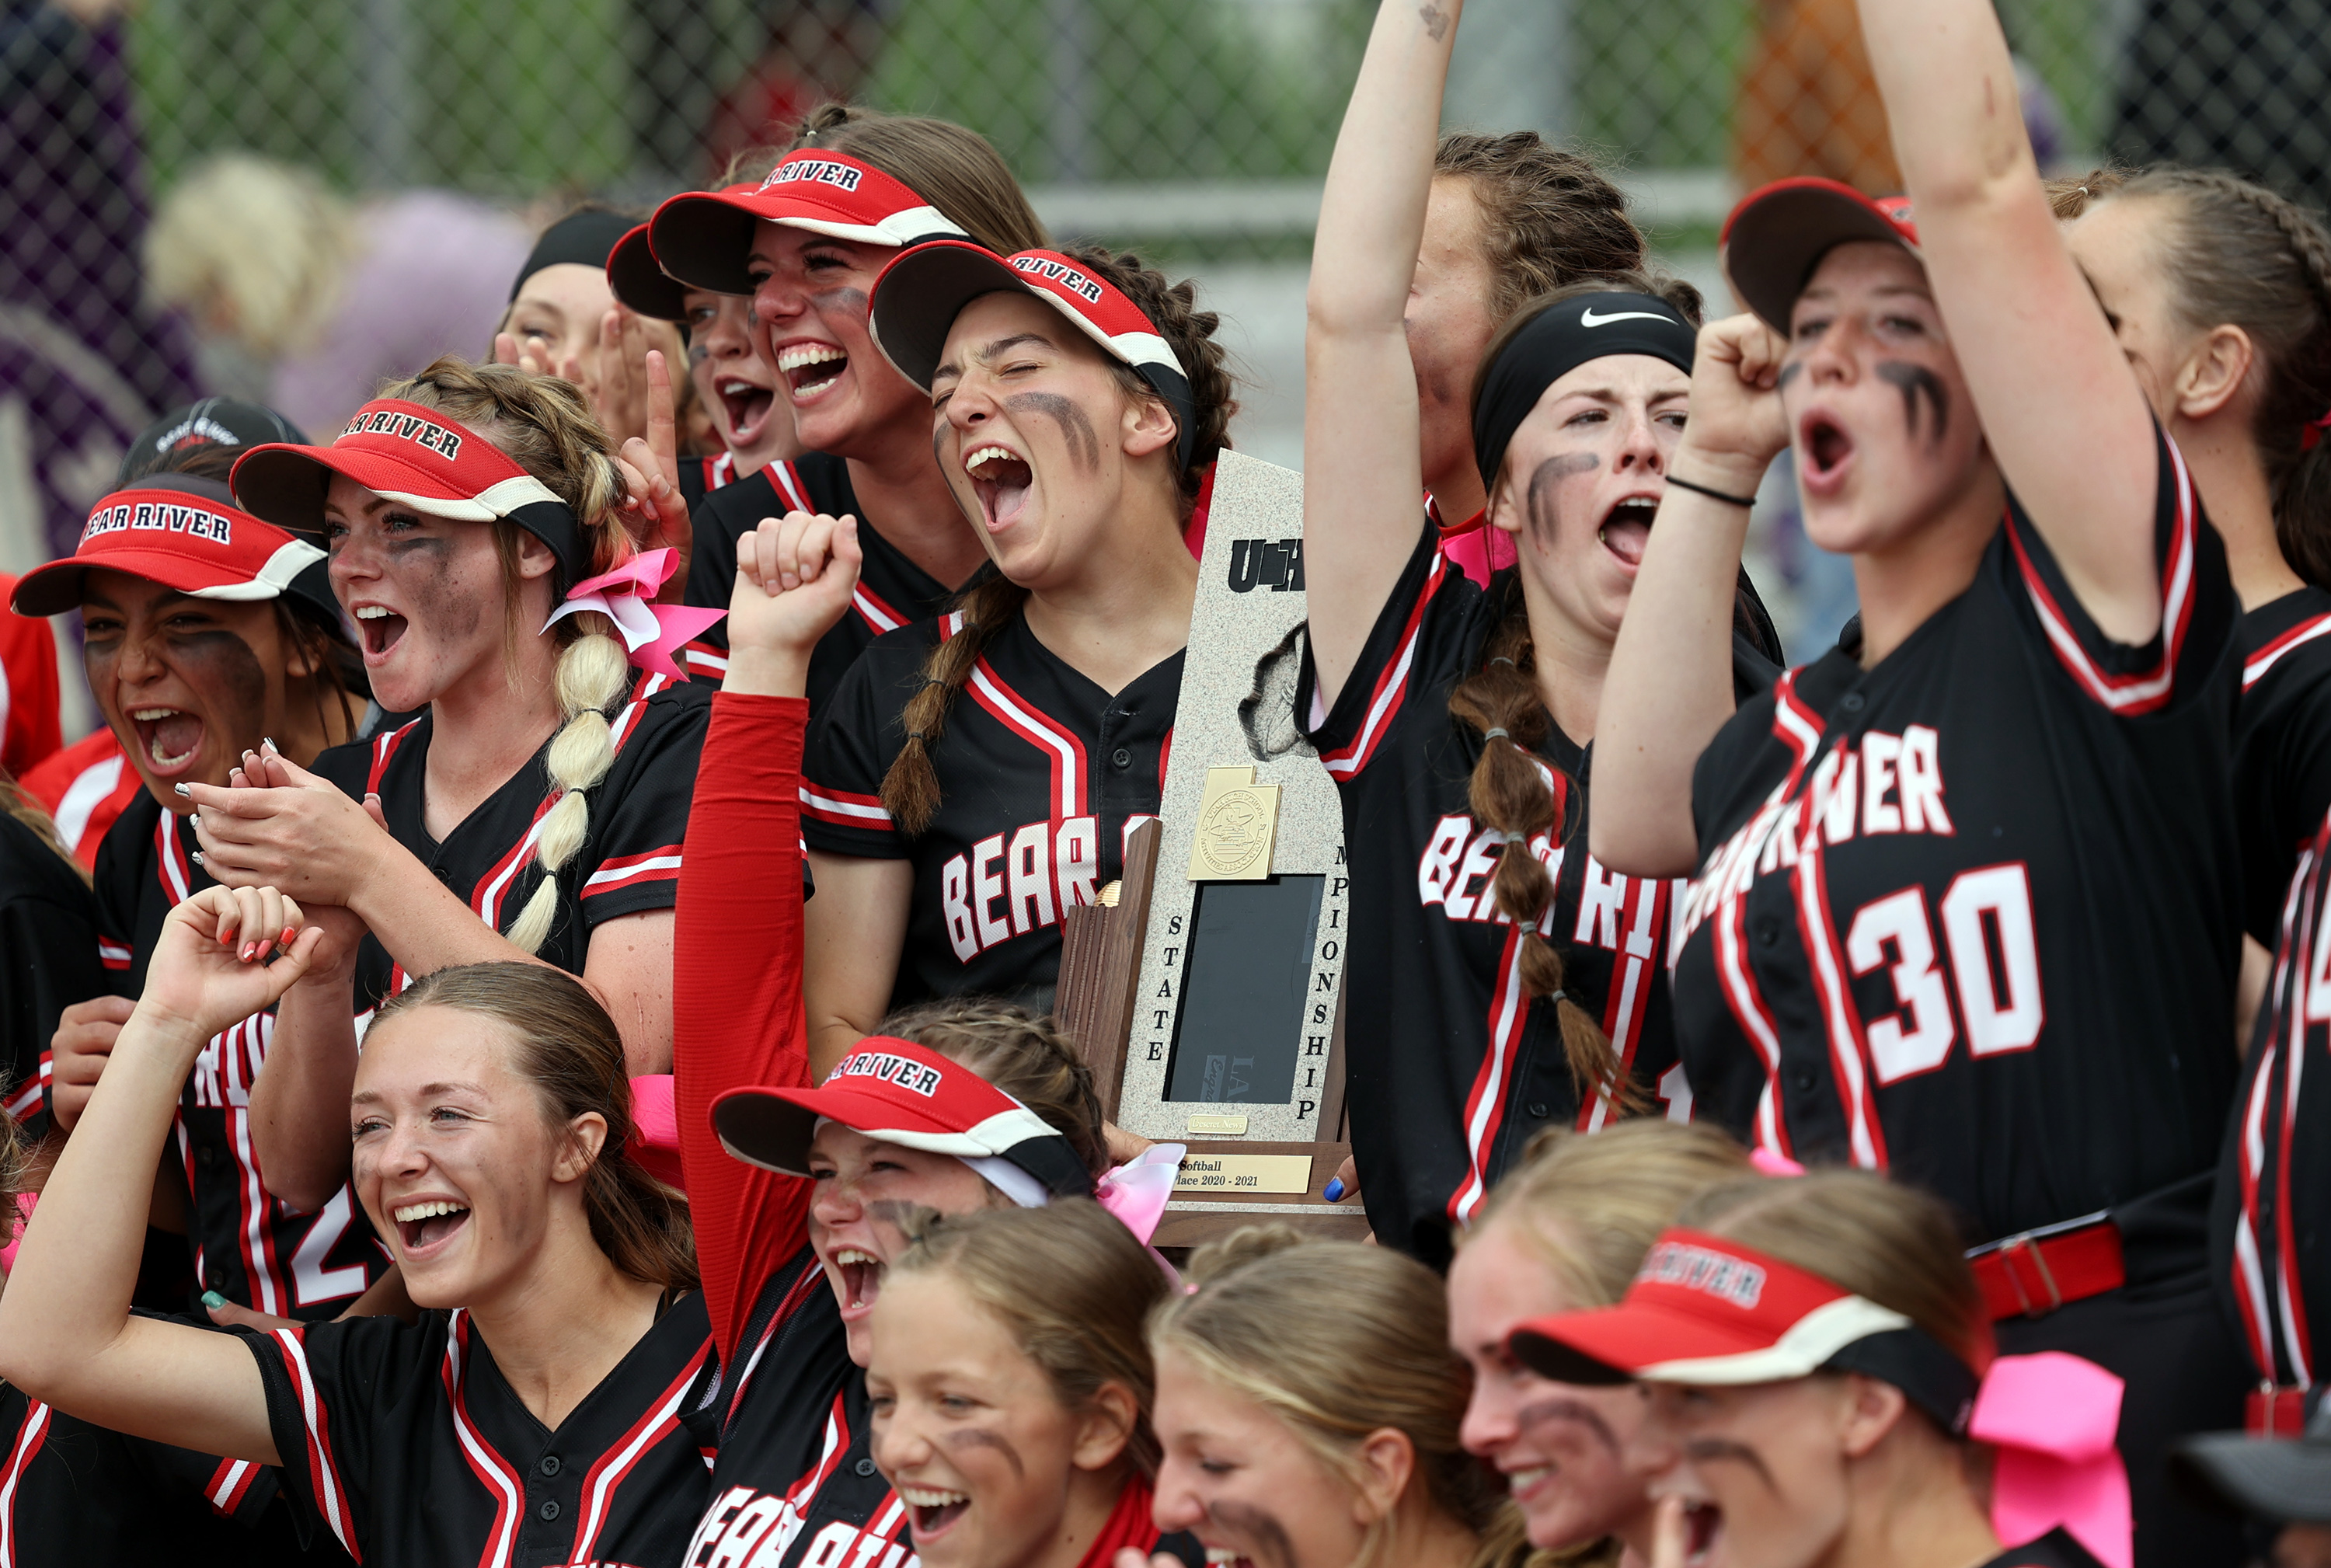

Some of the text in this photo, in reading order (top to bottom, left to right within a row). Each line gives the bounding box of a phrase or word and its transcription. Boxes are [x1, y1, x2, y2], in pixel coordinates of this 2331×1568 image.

[772, 160, 862, 192] RIVER
[1012, 257, 1103, 304] RIVER
[364, 410, 462, 462] RIVER
[79, 503, 232, 549] EAR RIVER
[942, 814, 1100, 966] BEAR
[1147, 916, 1182, 1061] STATE
[1296, 831, 1350, 1120] MPIONSHIP
[1845, 860, 2047, 1087] 30
[846, 1052, 943, 1098] RIVER
[1192, 1118, 1243, 1130] Deseret News
[1176, 1175, 1198, 1186] lace
[1201, 1176, 1225, 1186] 2020
[1235, 1176, 1258, 1186] 2021
[1179, 1160, 1221, 1172] Softball
